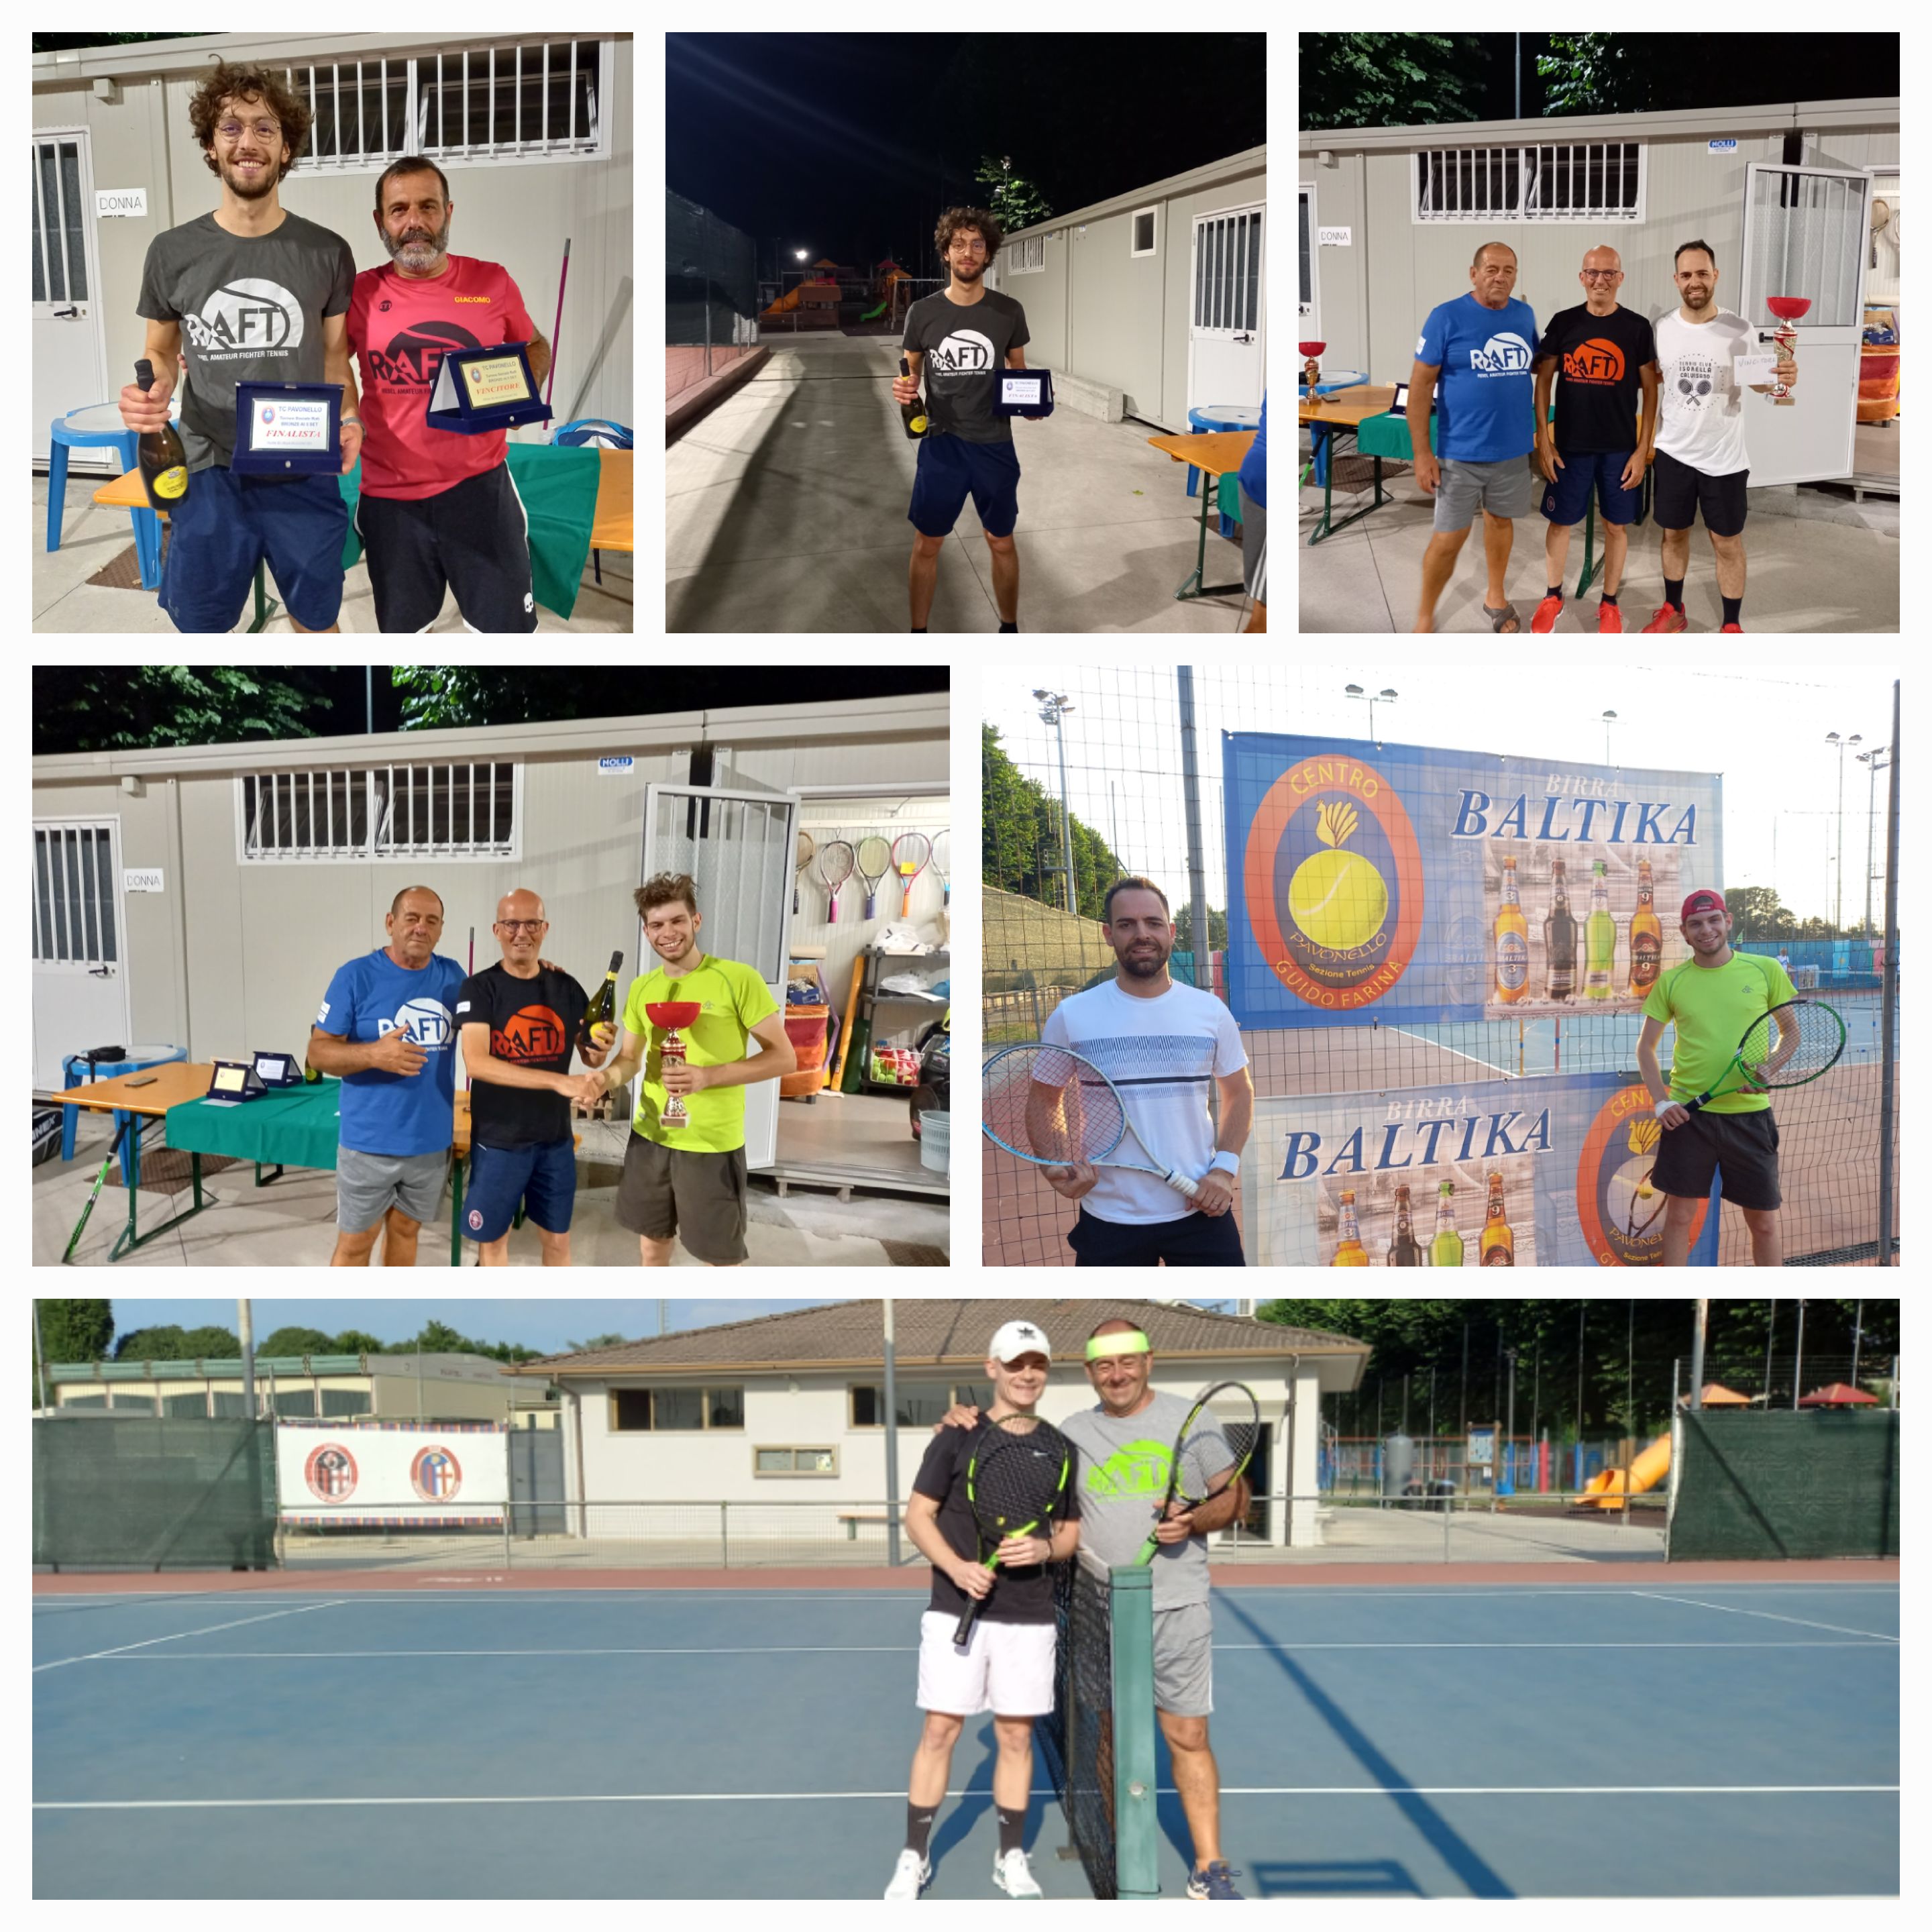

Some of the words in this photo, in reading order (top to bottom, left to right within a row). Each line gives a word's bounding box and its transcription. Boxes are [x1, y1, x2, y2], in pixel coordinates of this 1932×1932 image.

[99, 197, 142, 210] DONNA
[1321, 231, 1348, 240] DONNA
[184, 308, 280, 347] RAFT
[239, 351, 265, 359] FIGHTER
[929, 346, 983, 368] RAFT
[1470, 347, 1525, 370] RAFT
[1564, 354, 1615, 376] RAFT
[476, 382, 520, 394] VINCITORE
[1290, 762, 1379, 798] CENTRO
[1546, 773, 1619, 798] BIRRA
[1450, 789, 1698, 845] BALTIKA
[127, 875, 160, 885] DONNA
[1507, 891, 1515, 900] 3
[1642, 892, 1650, 902] 9
[1290, 932, 1387, 963] PAVONELLO
[1309, 963, 1344, 978] Sezione
[1346, 964, 1375, 977] Tennis
[1507, 963, 1517, 973] 3
[1642, 962, 1651, 972] 9
[1276, 960, 1334, 1006] GUIDO
[1341, 961, 1403, 1006] FARINA
[490, 1026, 555, 1055] RAFT
[1385, 1095, 1467, 1122] BIRRA
[1611, 1090, 1653, 1117] CEN
[1277, 1107, 1554, 1181] BALTIKA
[1492, 1205, 1501, 1215] 9
[1344, 1228, 1354, 1237] 3
[1609, 1227, 1663, 1247] PAVONEL
[1623, 1252, 1648, 1261] Sezione
